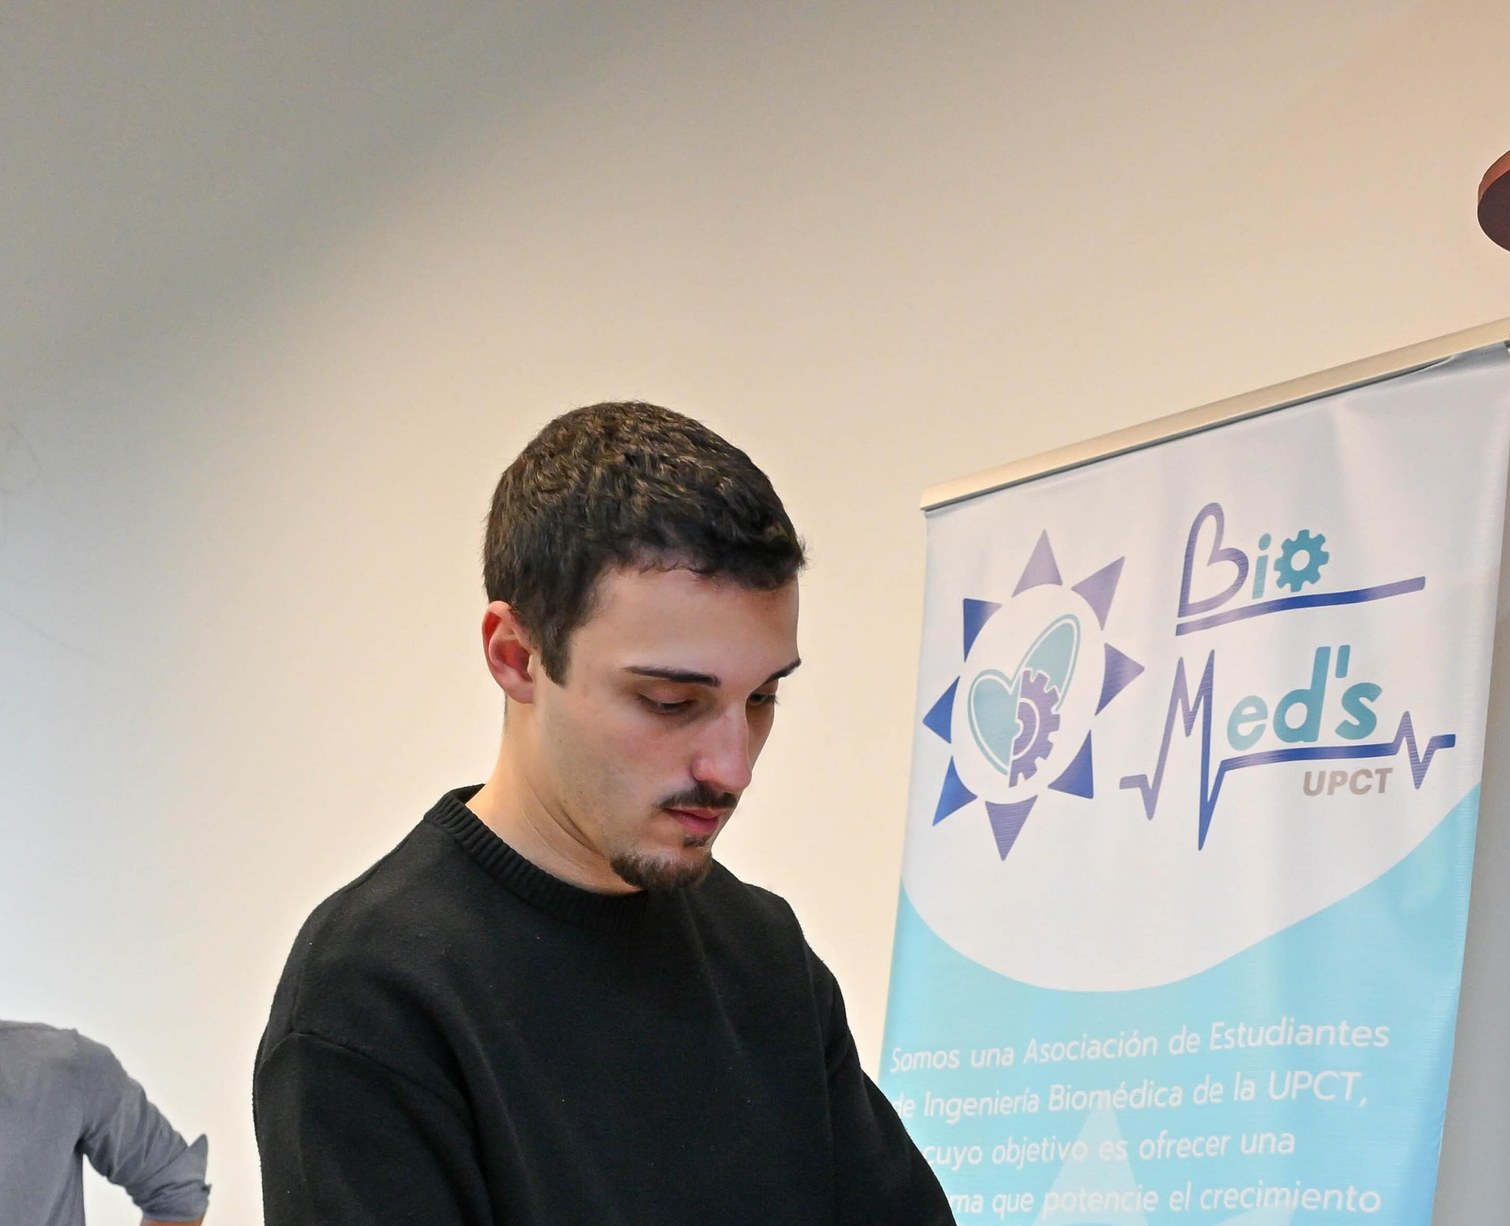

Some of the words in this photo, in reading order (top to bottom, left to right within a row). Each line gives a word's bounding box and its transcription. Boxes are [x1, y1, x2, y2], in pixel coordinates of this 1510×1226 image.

[1303, 767, 1394, 797] UPCT
[890, 1047, 960, 1073] Somos
[971, 1045, 1014, 1069] una
[1023, 1030, 1158, 1065] Asociación
[1168, 1024, 1200, 1056] de
[1209, 1015, 1390, 1051] Estudiantes
[924, 1087, 1040, 1125] Ingeniería
[1048, 1079, 1183, 1112] Biomédica
[1193, 1073, 1224, 1105] de
[1233, 1071, 1256, 1102] la
[1268, 1070, 1369, 1108] UPCT,
[924, 1144, 984, 1172] cuyo
[992, 1135, 1088, 1171] objetivo
[1099, 1138, 1127, 1161] es
[1138, 1129, 1231, 1161] ofrecer
[1240, 1131, 1296, 1156] una
[991, 1193, 1034, 1219] que
[1043, 1184, 1159, 1220] potencie
[1169, 1180, 1193, 1212] el
[1200, 1179, 1382, 1214] crecimiento
